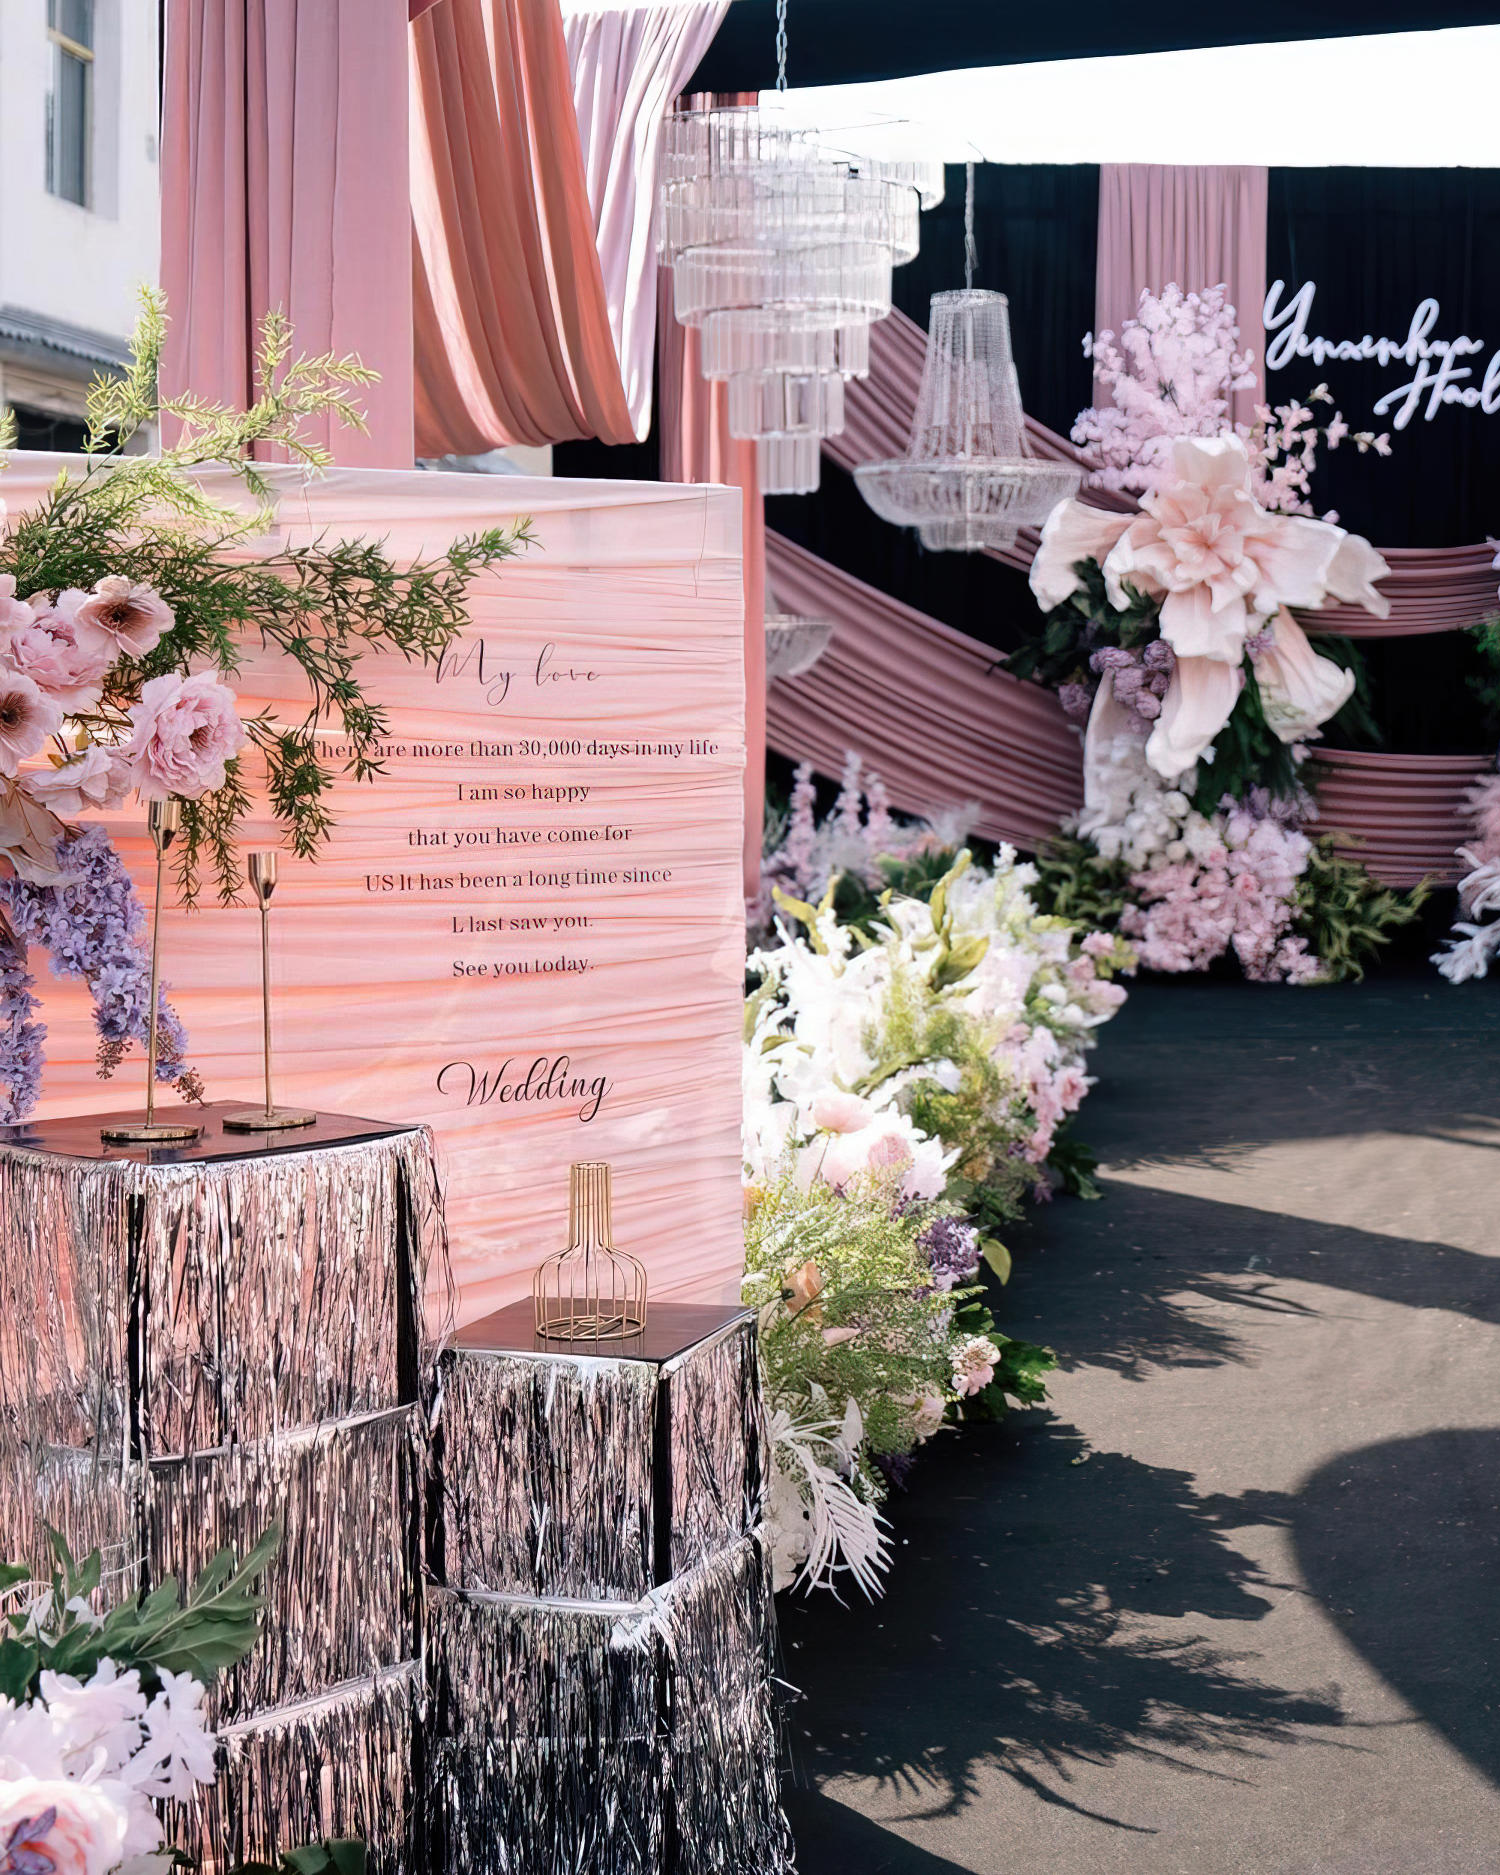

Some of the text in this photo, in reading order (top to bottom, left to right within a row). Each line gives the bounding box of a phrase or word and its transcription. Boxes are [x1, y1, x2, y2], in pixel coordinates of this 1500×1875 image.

[435, 636, 601, 706] My love
[374, 742, 406, 758] are
[412, 741, 464, 757] more
[470, 738, 513, 757] than
[518, 738, 582, 760] 30,000
[586, 738, 630, 759] days
[634, 738, 652, 756] in
[656, 740, 684, 759] my
[689, 738, 719, 756] life
[469, 787, 498, 801] am
[504, 786, 526, 800] so
[531, 783, 591, 803] happy
[408, 825, 633, 849] that you have come for
[365, 873, 394, 893] US
[420, 872, 454, 890] has
[459, 871, 507, 889] been
[512, 874, 524, 888] a
[528, 869, 570, 891] long
[576, 867, 618, 886] time
[622, 866, 673, 884] since
[469, 915, 504, 932] last
[510, 916, 548, 931] saw
[453, 956, 594, 978] See you today.
[436, 1055, 614, 1123] Wedding
